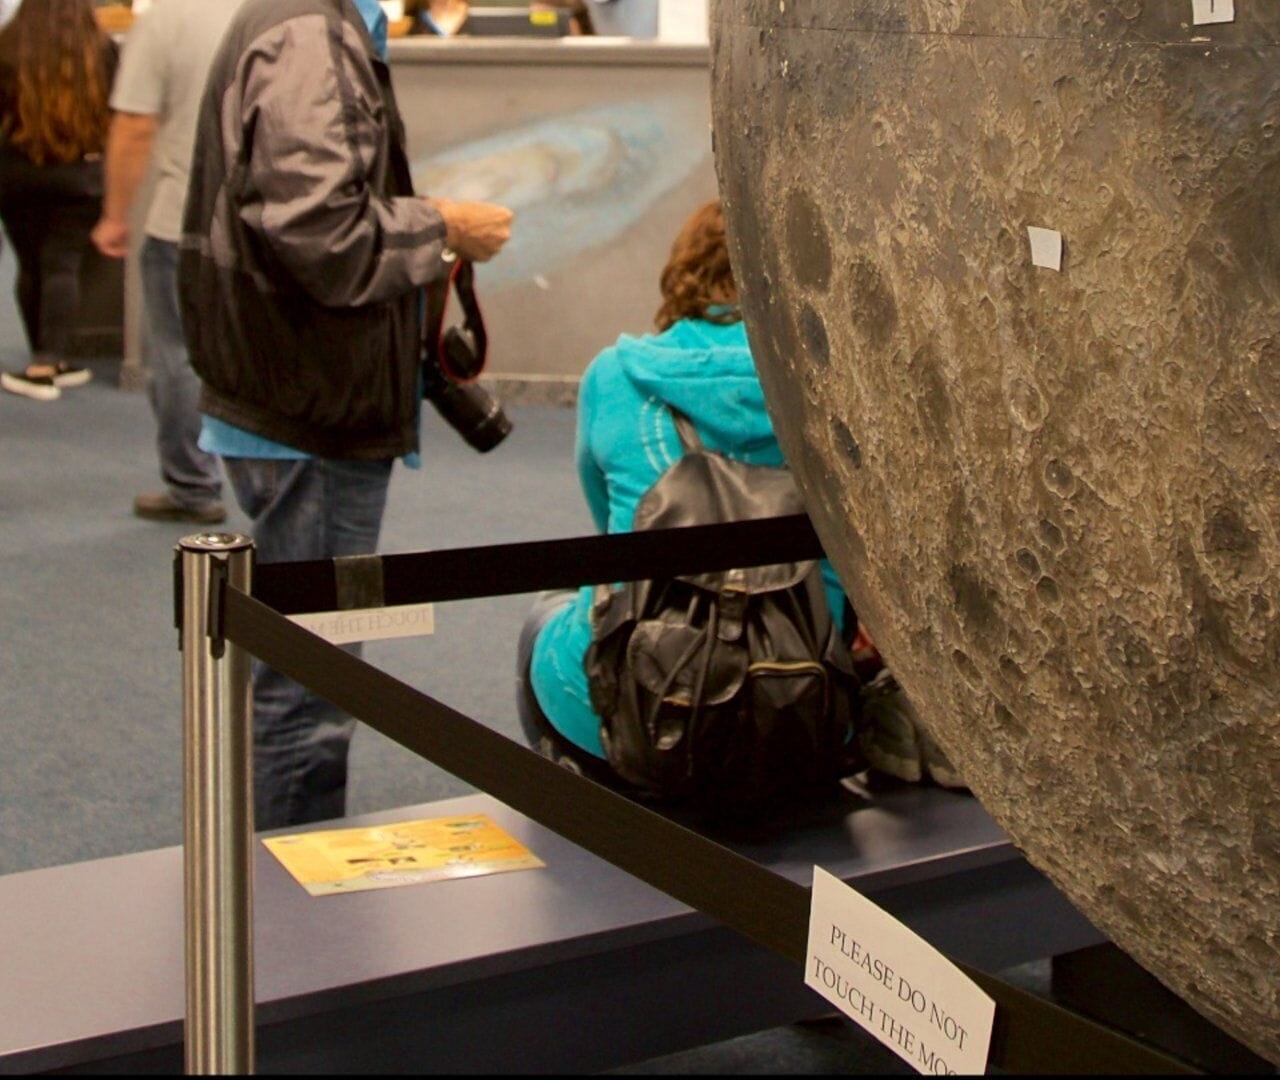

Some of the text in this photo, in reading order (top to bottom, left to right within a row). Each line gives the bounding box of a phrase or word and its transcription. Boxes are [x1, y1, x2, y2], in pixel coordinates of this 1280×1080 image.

[813, 955, 958, 1076] TOUCH THE MO
[830, 923, 969, 1052] PLEASE DO NOT
